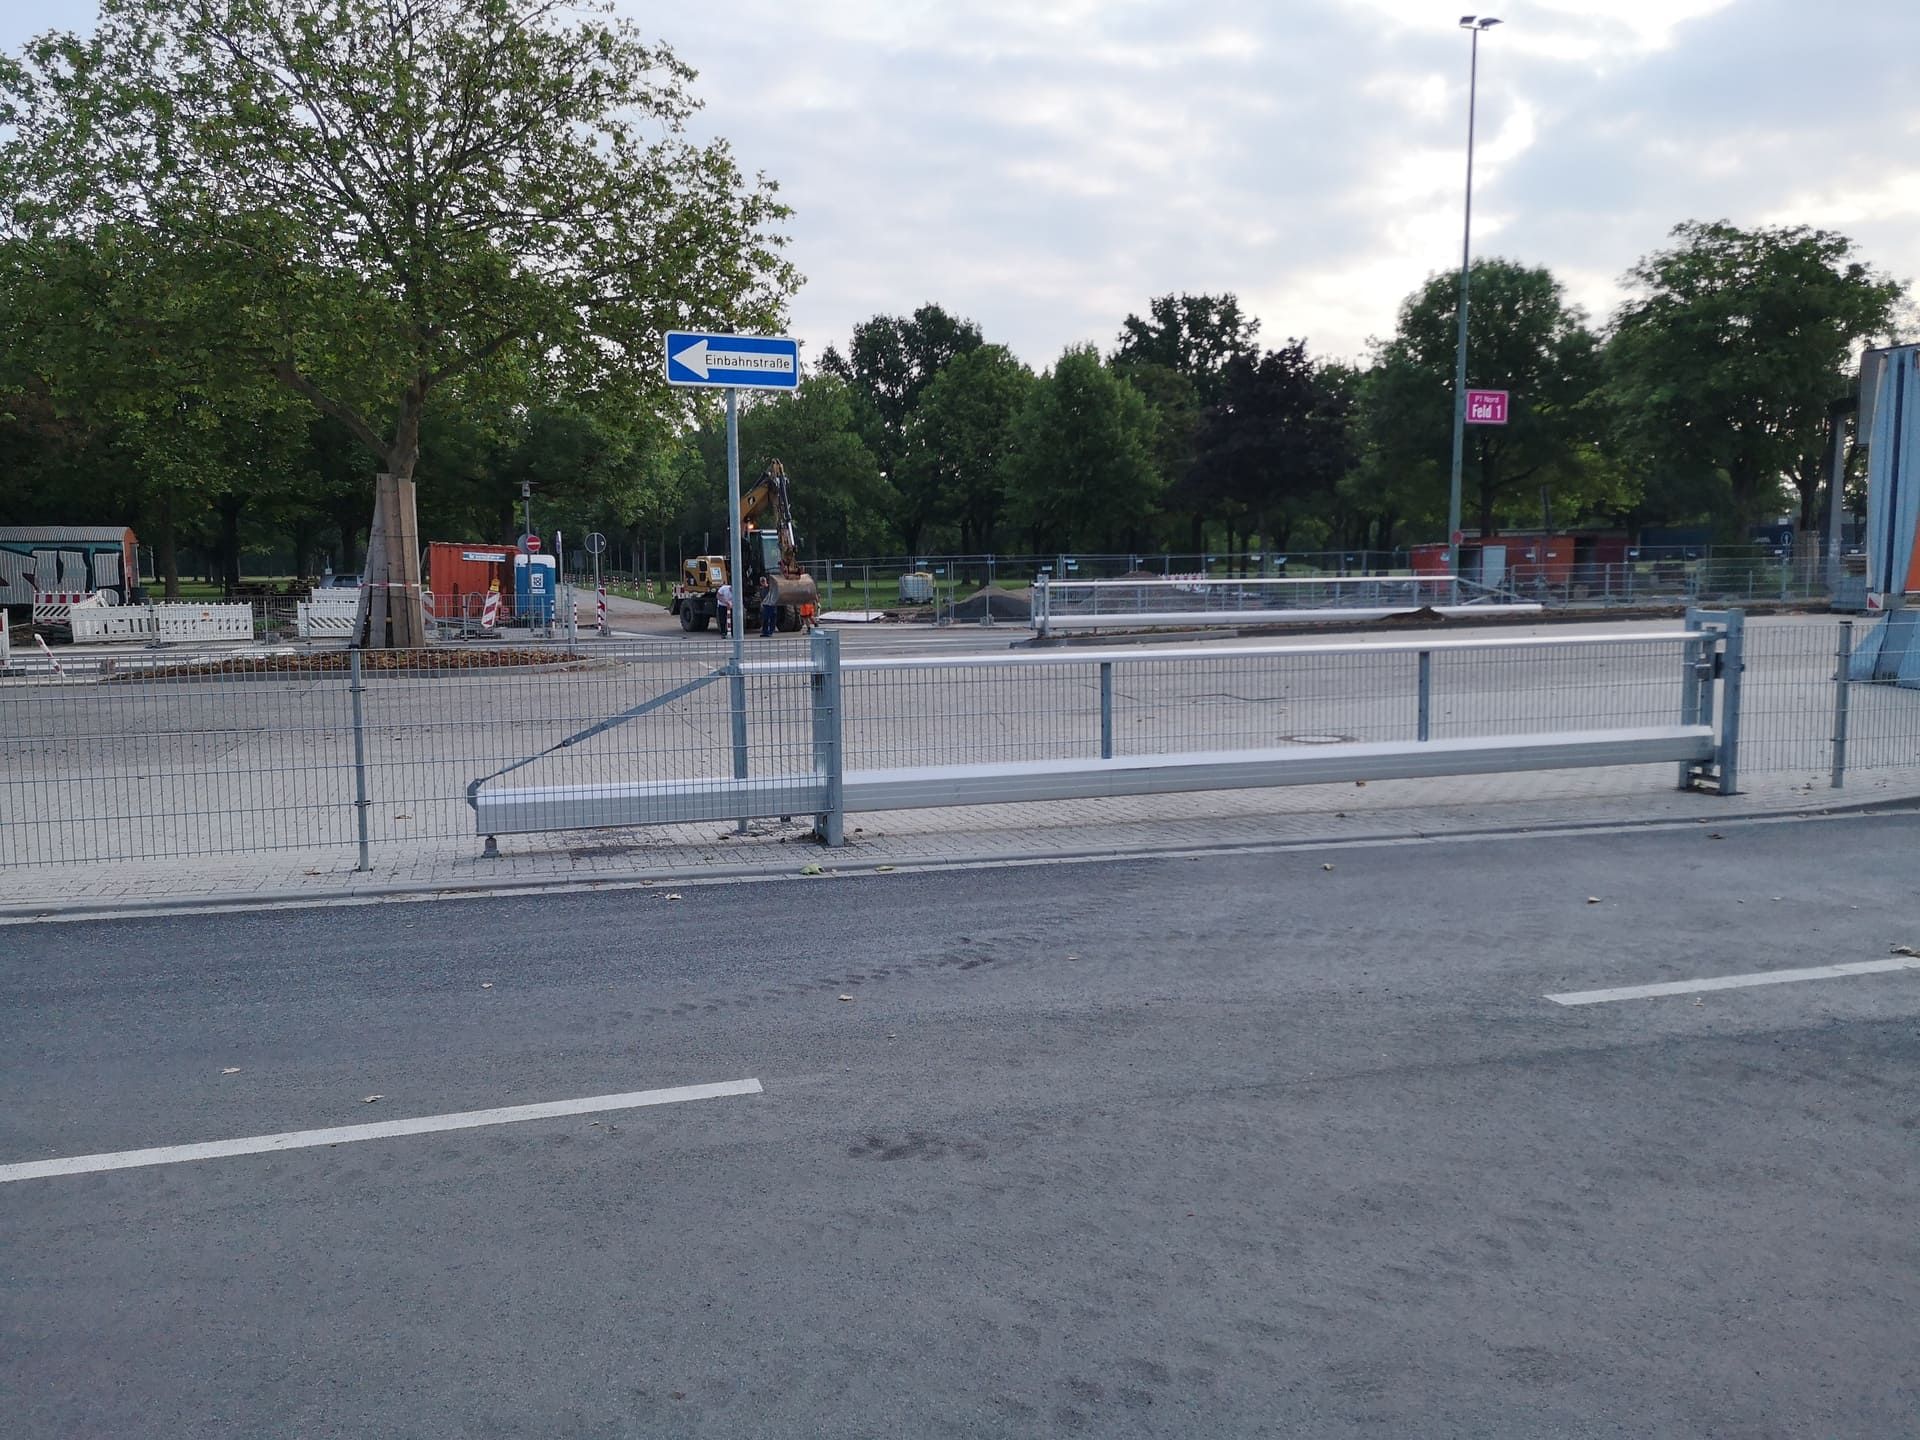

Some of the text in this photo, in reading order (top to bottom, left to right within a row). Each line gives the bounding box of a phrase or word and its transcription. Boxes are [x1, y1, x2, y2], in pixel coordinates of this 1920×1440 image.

[705, 354, 790, 368] Einbahnstraße
[1472, 404, 1501, 418] Feld 1
